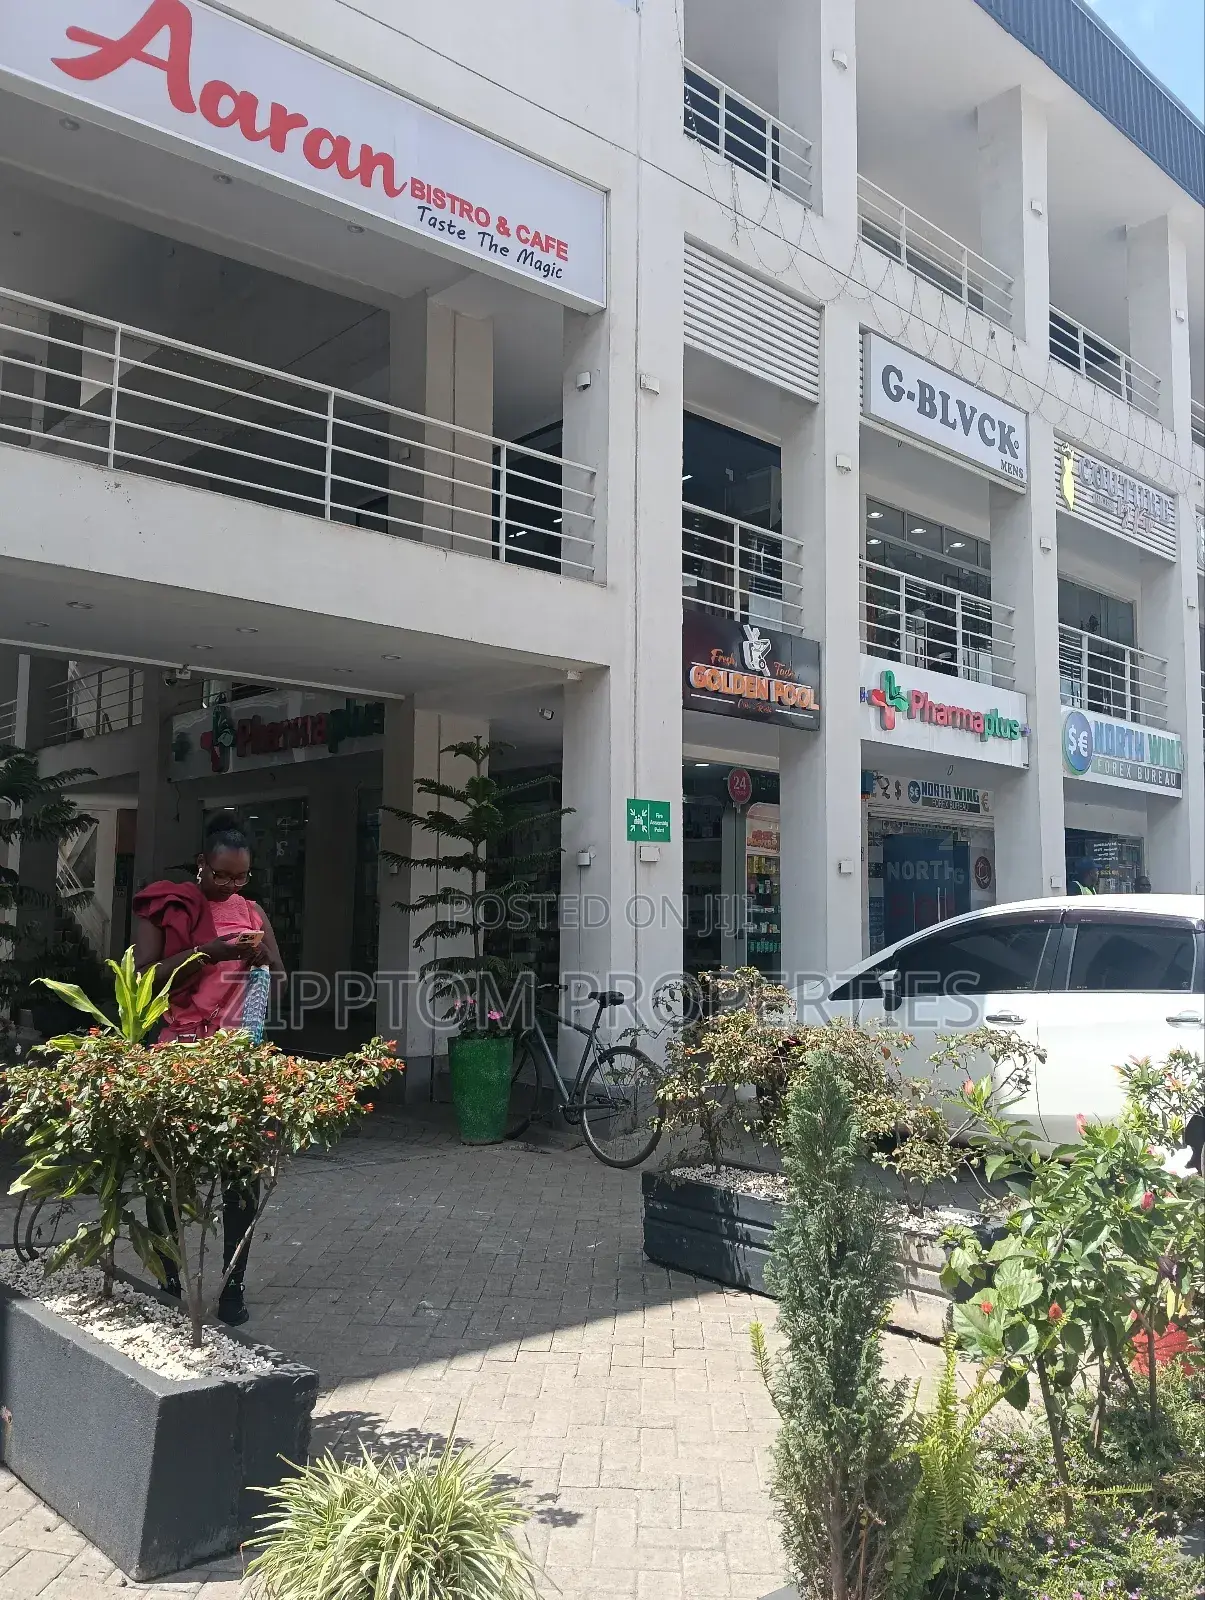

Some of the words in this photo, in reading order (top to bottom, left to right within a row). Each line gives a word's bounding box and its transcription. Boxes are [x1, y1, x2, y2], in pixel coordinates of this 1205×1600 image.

[51, 0, 407, 198] Aaran
[410, 177, 491, 228] BISTRO
[496, 216, 511, 238] &
[516, 225, 568, 261] CAFE
[417, 205, 466, 239] Taste
[478, 231, 509, 256] The
[517, 248, 563, 278] Magic
[1000, 459, 1024, 479] MENS
[690, 665, 768, 701] GOLDEN
[769, 679, 820, 711] POOL
[907, 690, 1020, 742] Pharmaplus
[1093, 720, 1145, 762] NORTH
[733, 775, 747, 790] 24
[921, 781, 951, 799] NORTH
[953, 786, 980, 804] WING
[1097, 758, 1132, 779] FOREX
[1137, 766, 1177, 787] BUREAU
